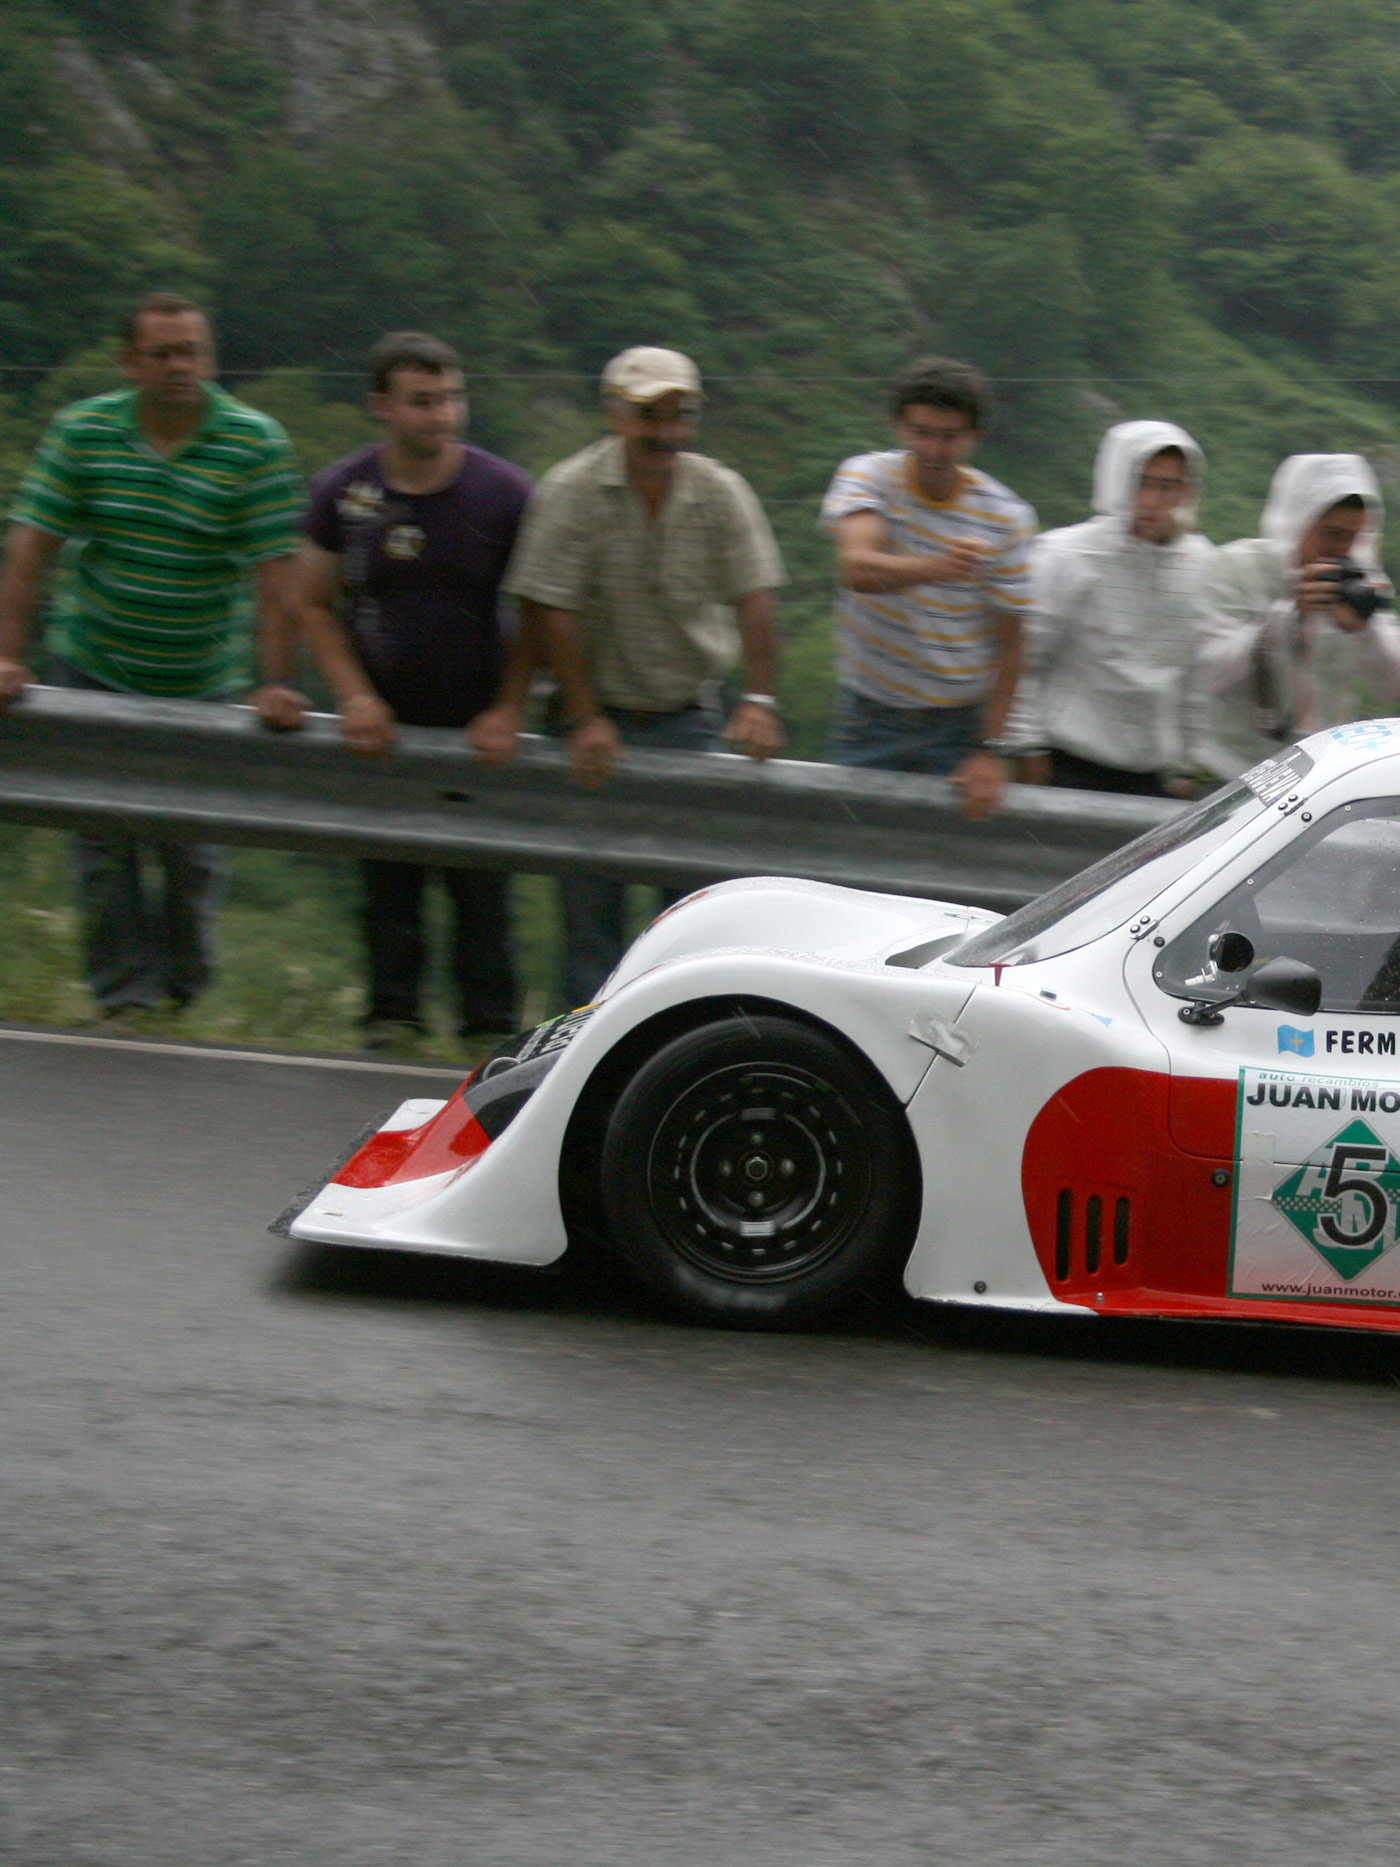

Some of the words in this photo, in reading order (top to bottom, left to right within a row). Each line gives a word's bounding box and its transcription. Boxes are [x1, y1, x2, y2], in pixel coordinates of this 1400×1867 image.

[1258, 1071, 1296, 1082] auto
[1246, 1083, 1341, 1111] JUAN
[1320, 1145, 1388, 1247] 5
